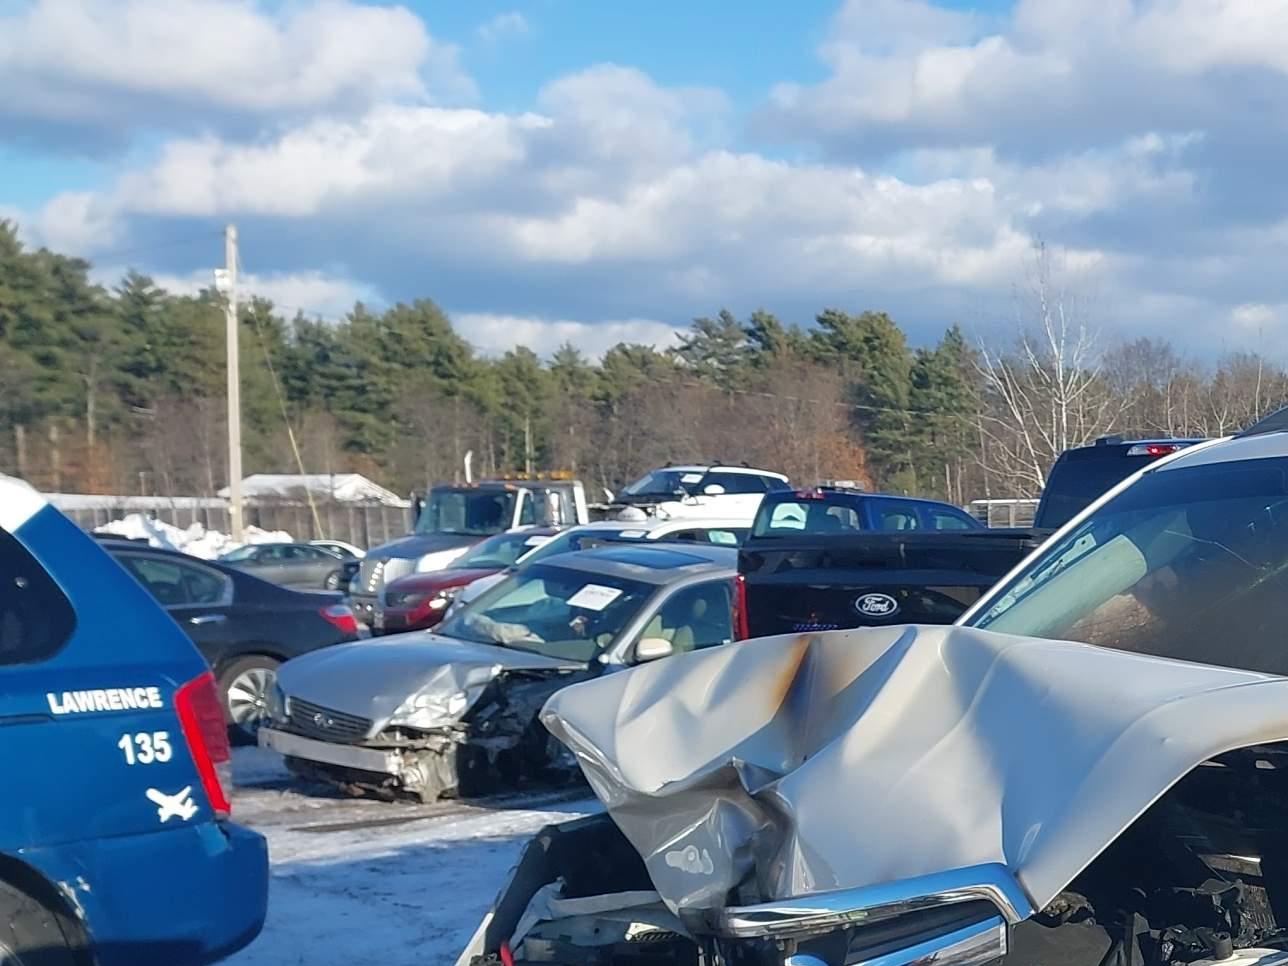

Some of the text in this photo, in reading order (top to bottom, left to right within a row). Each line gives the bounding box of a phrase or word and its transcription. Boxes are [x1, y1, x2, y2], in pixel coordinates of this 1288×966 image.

[862, 596, 890, 612] Ford
[46, 686, 164, 715] LAWRENCE
[117, 731, 173, 765] 135
